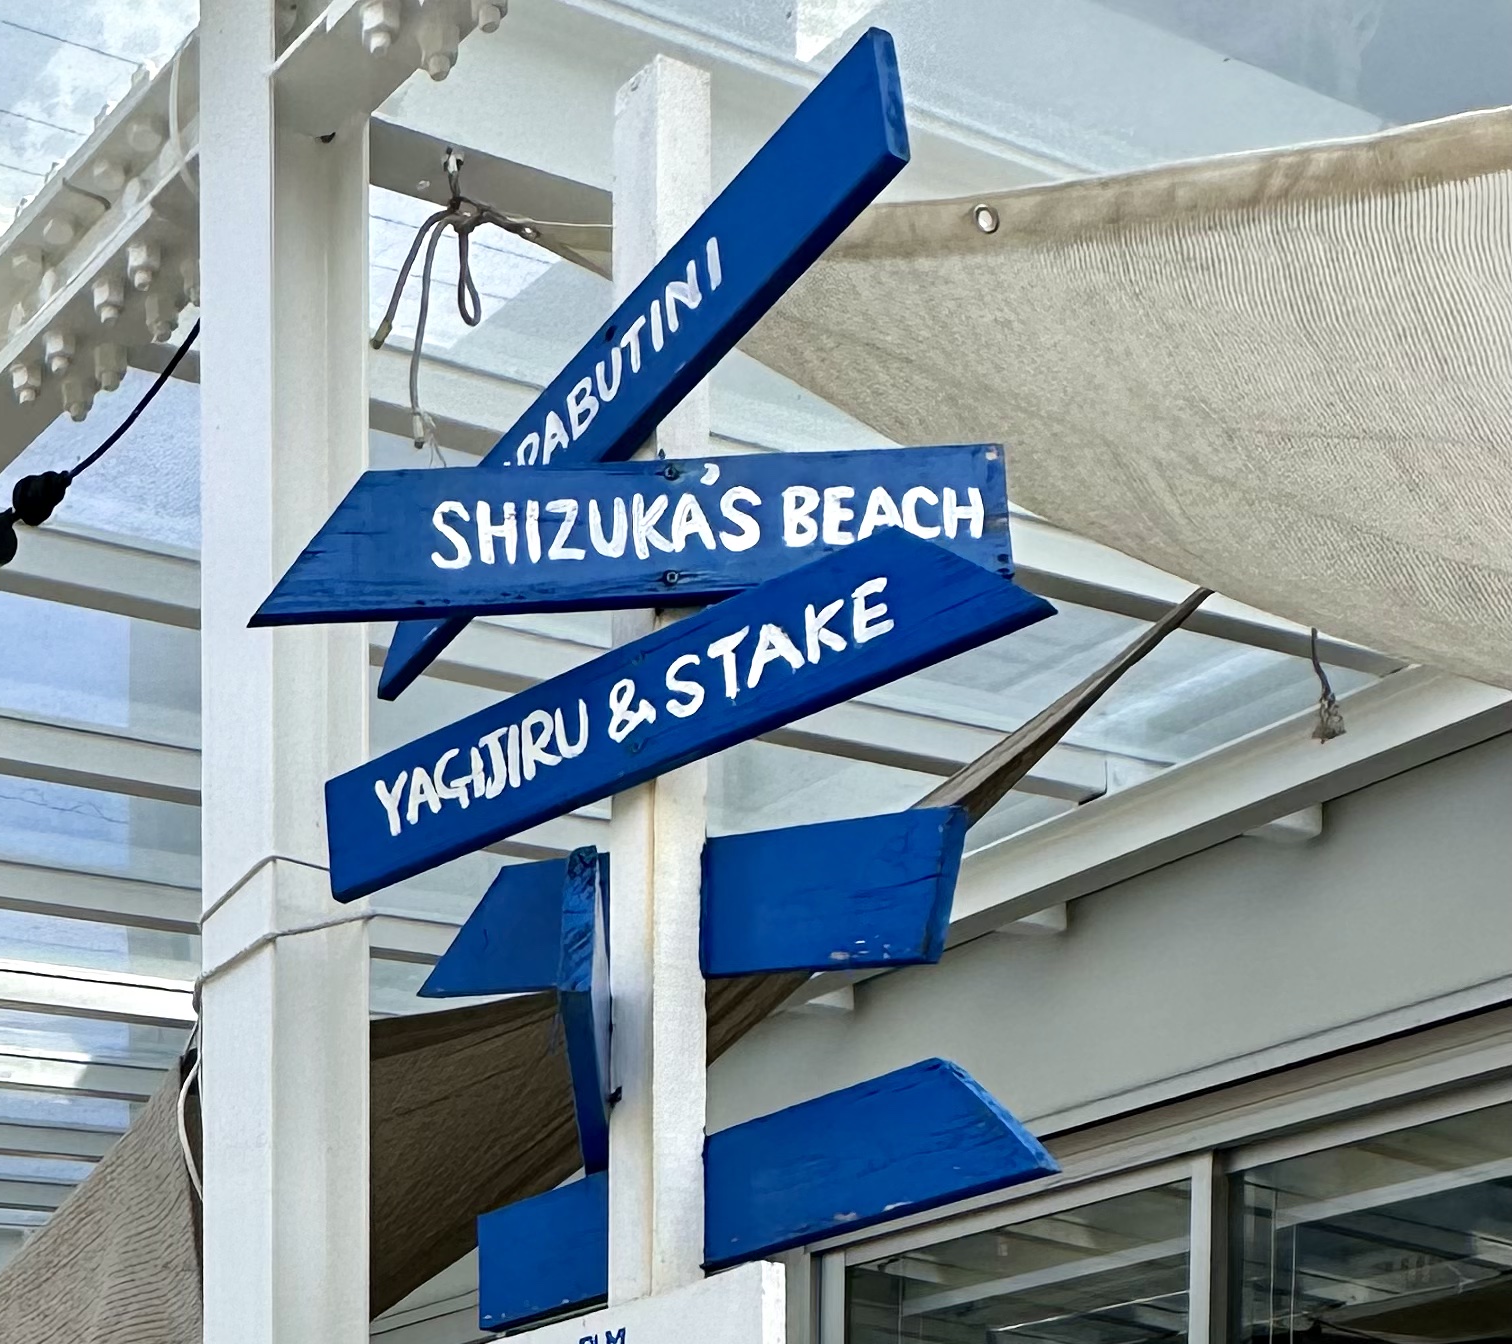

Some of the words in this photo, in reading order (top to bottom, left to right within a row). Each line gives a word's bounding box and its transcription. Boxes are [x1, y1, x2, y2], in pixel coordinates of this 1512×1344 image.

[431, 463, 761, 570] SHIZUKA'S
[782, 485, 985, 548] BEACH
[374, 699, 589, 837] YAGIJIRU
[608, 678, 657, 743] &
[666, 577, 894, 718] STAKE
